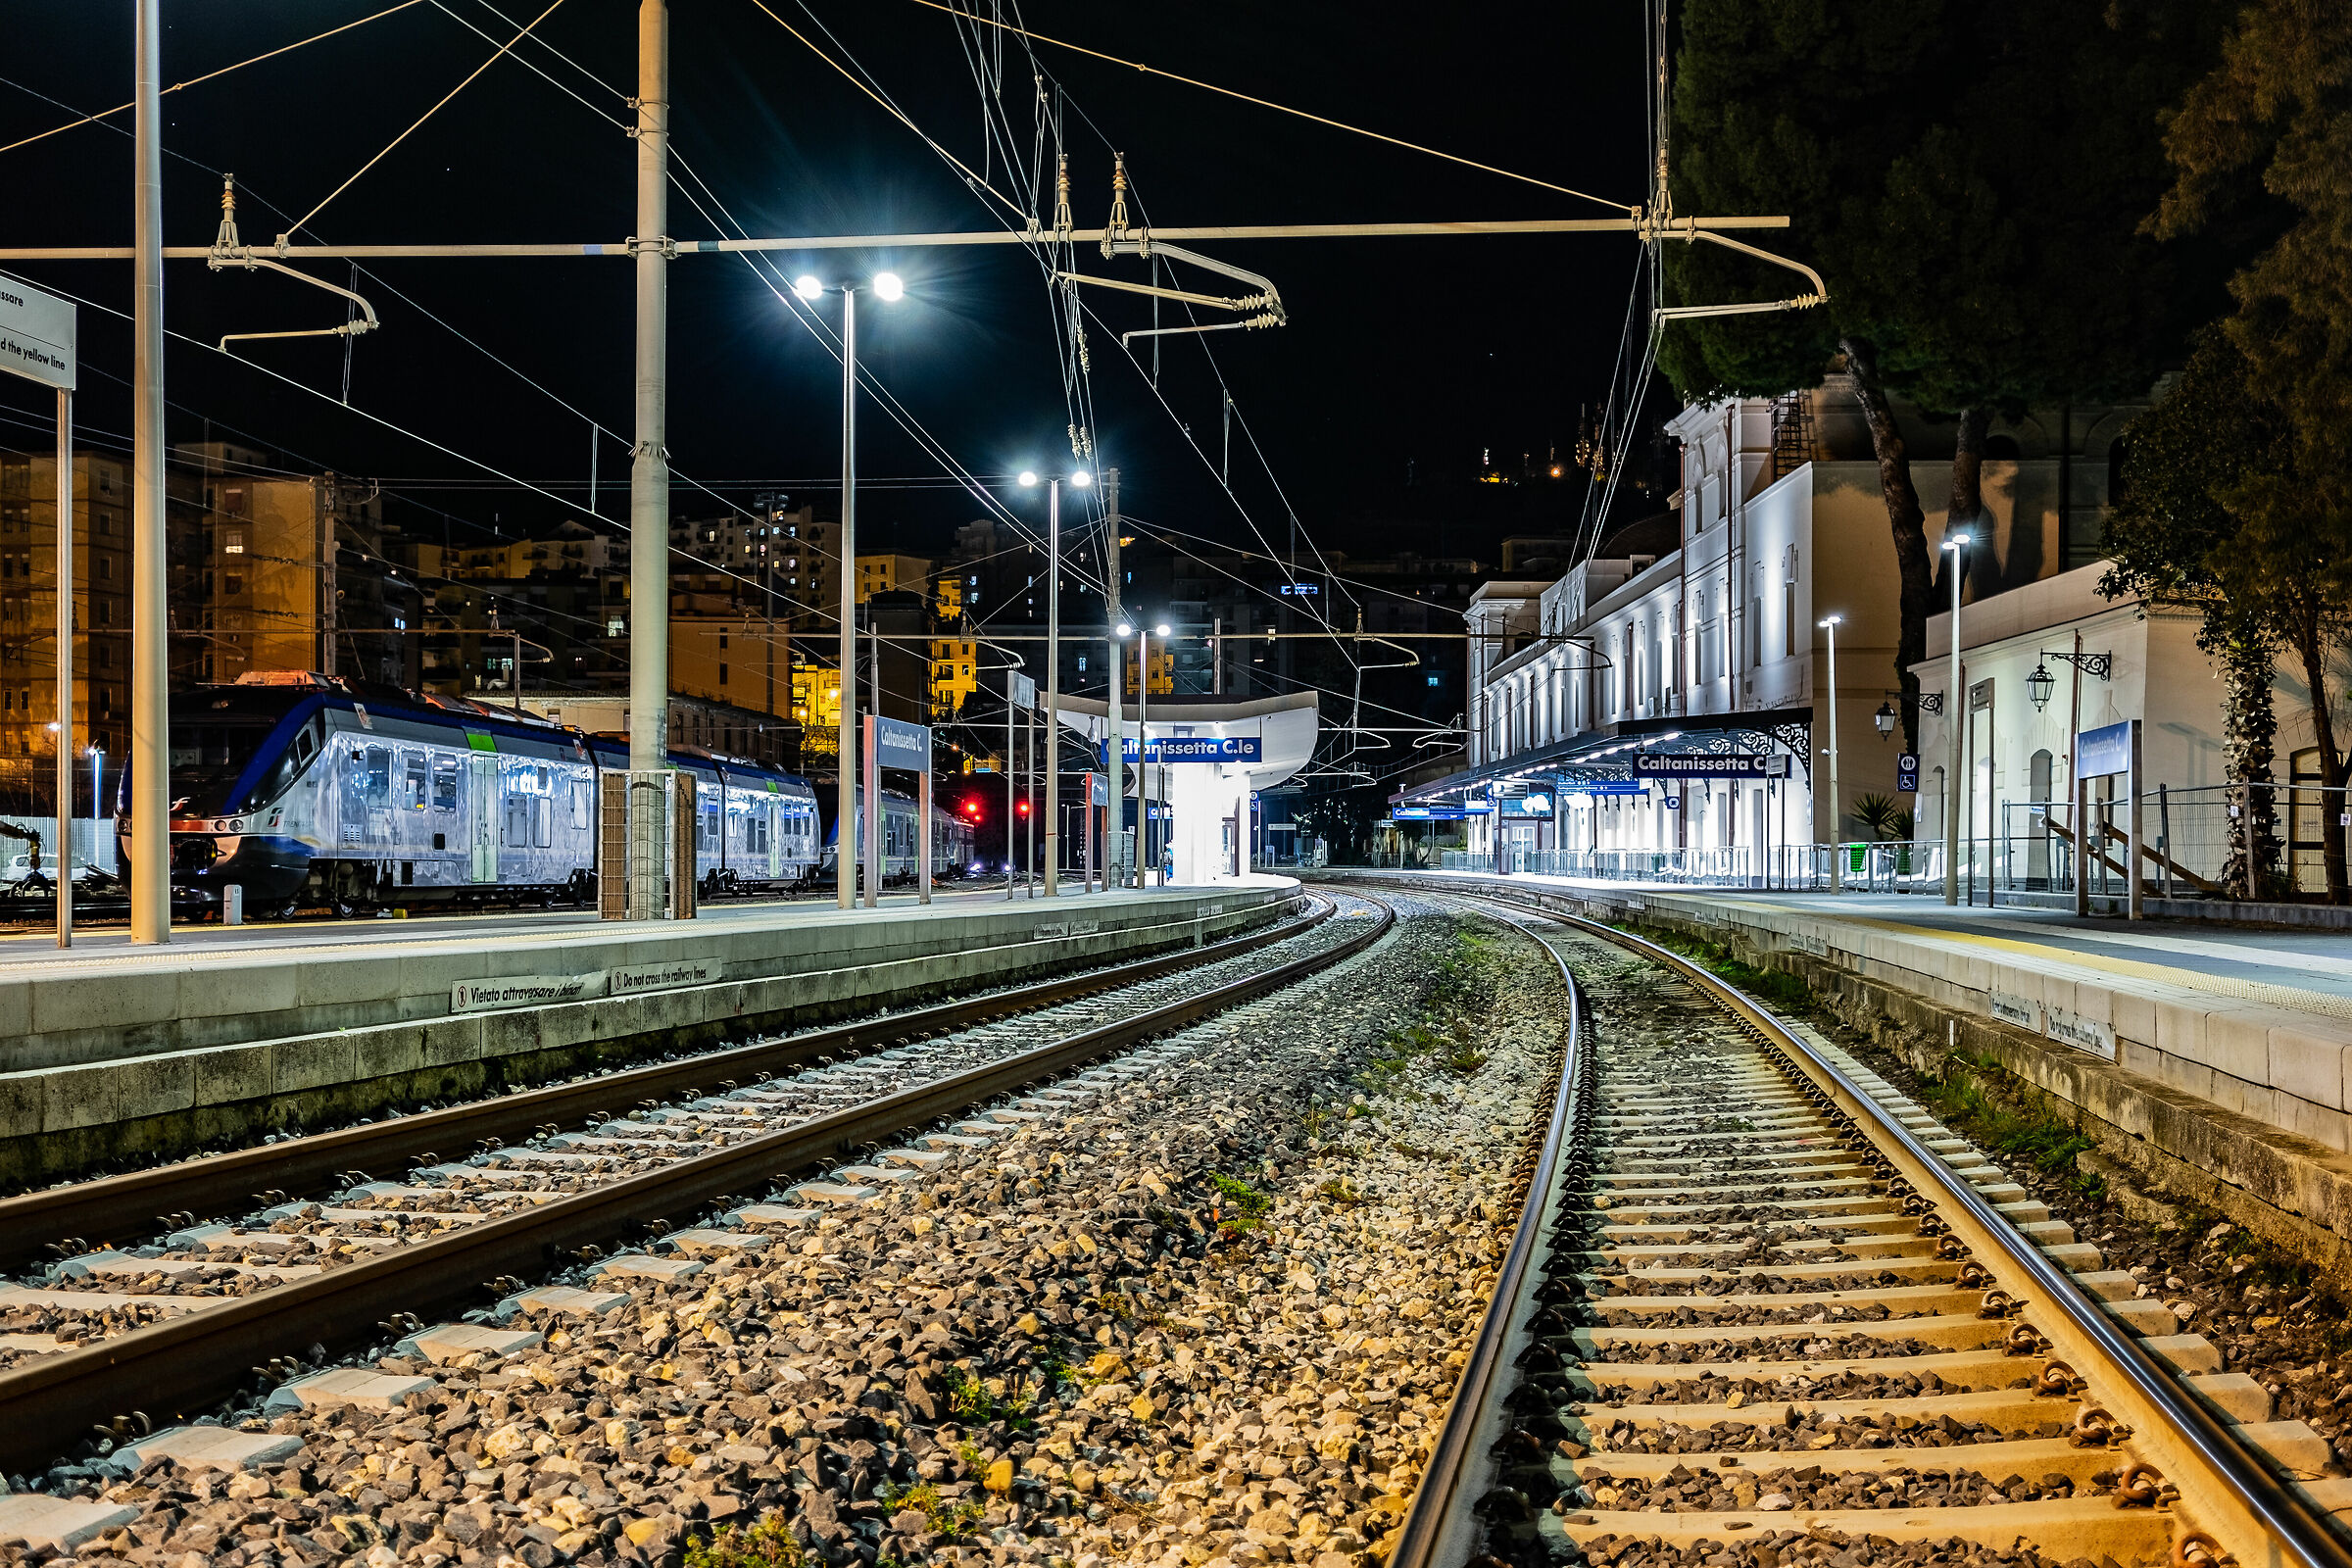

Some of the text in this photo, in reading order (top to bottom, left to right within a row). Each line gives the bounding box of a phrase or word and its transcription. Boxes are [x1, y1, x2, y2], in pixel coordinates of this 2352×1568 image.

[0, 290, 24, 307] ssare
[8, 340, 22, 355] the
[23, 347, 49, 366] yellow
[50, 354, 66, 370] line
[880, 724, 917, 752] Caltanissetta
[1105, 739, 1254, 755] altanissetta C.le
[1638, 756, 1749, 770] Caltanissetta
[623, 965, 707, 988] Do not cross the railway lines
[470, 987, 500, 1004] Vietato
[502, 986, 556, 1002] attraversare
[559, 981, 585, 997] binari
